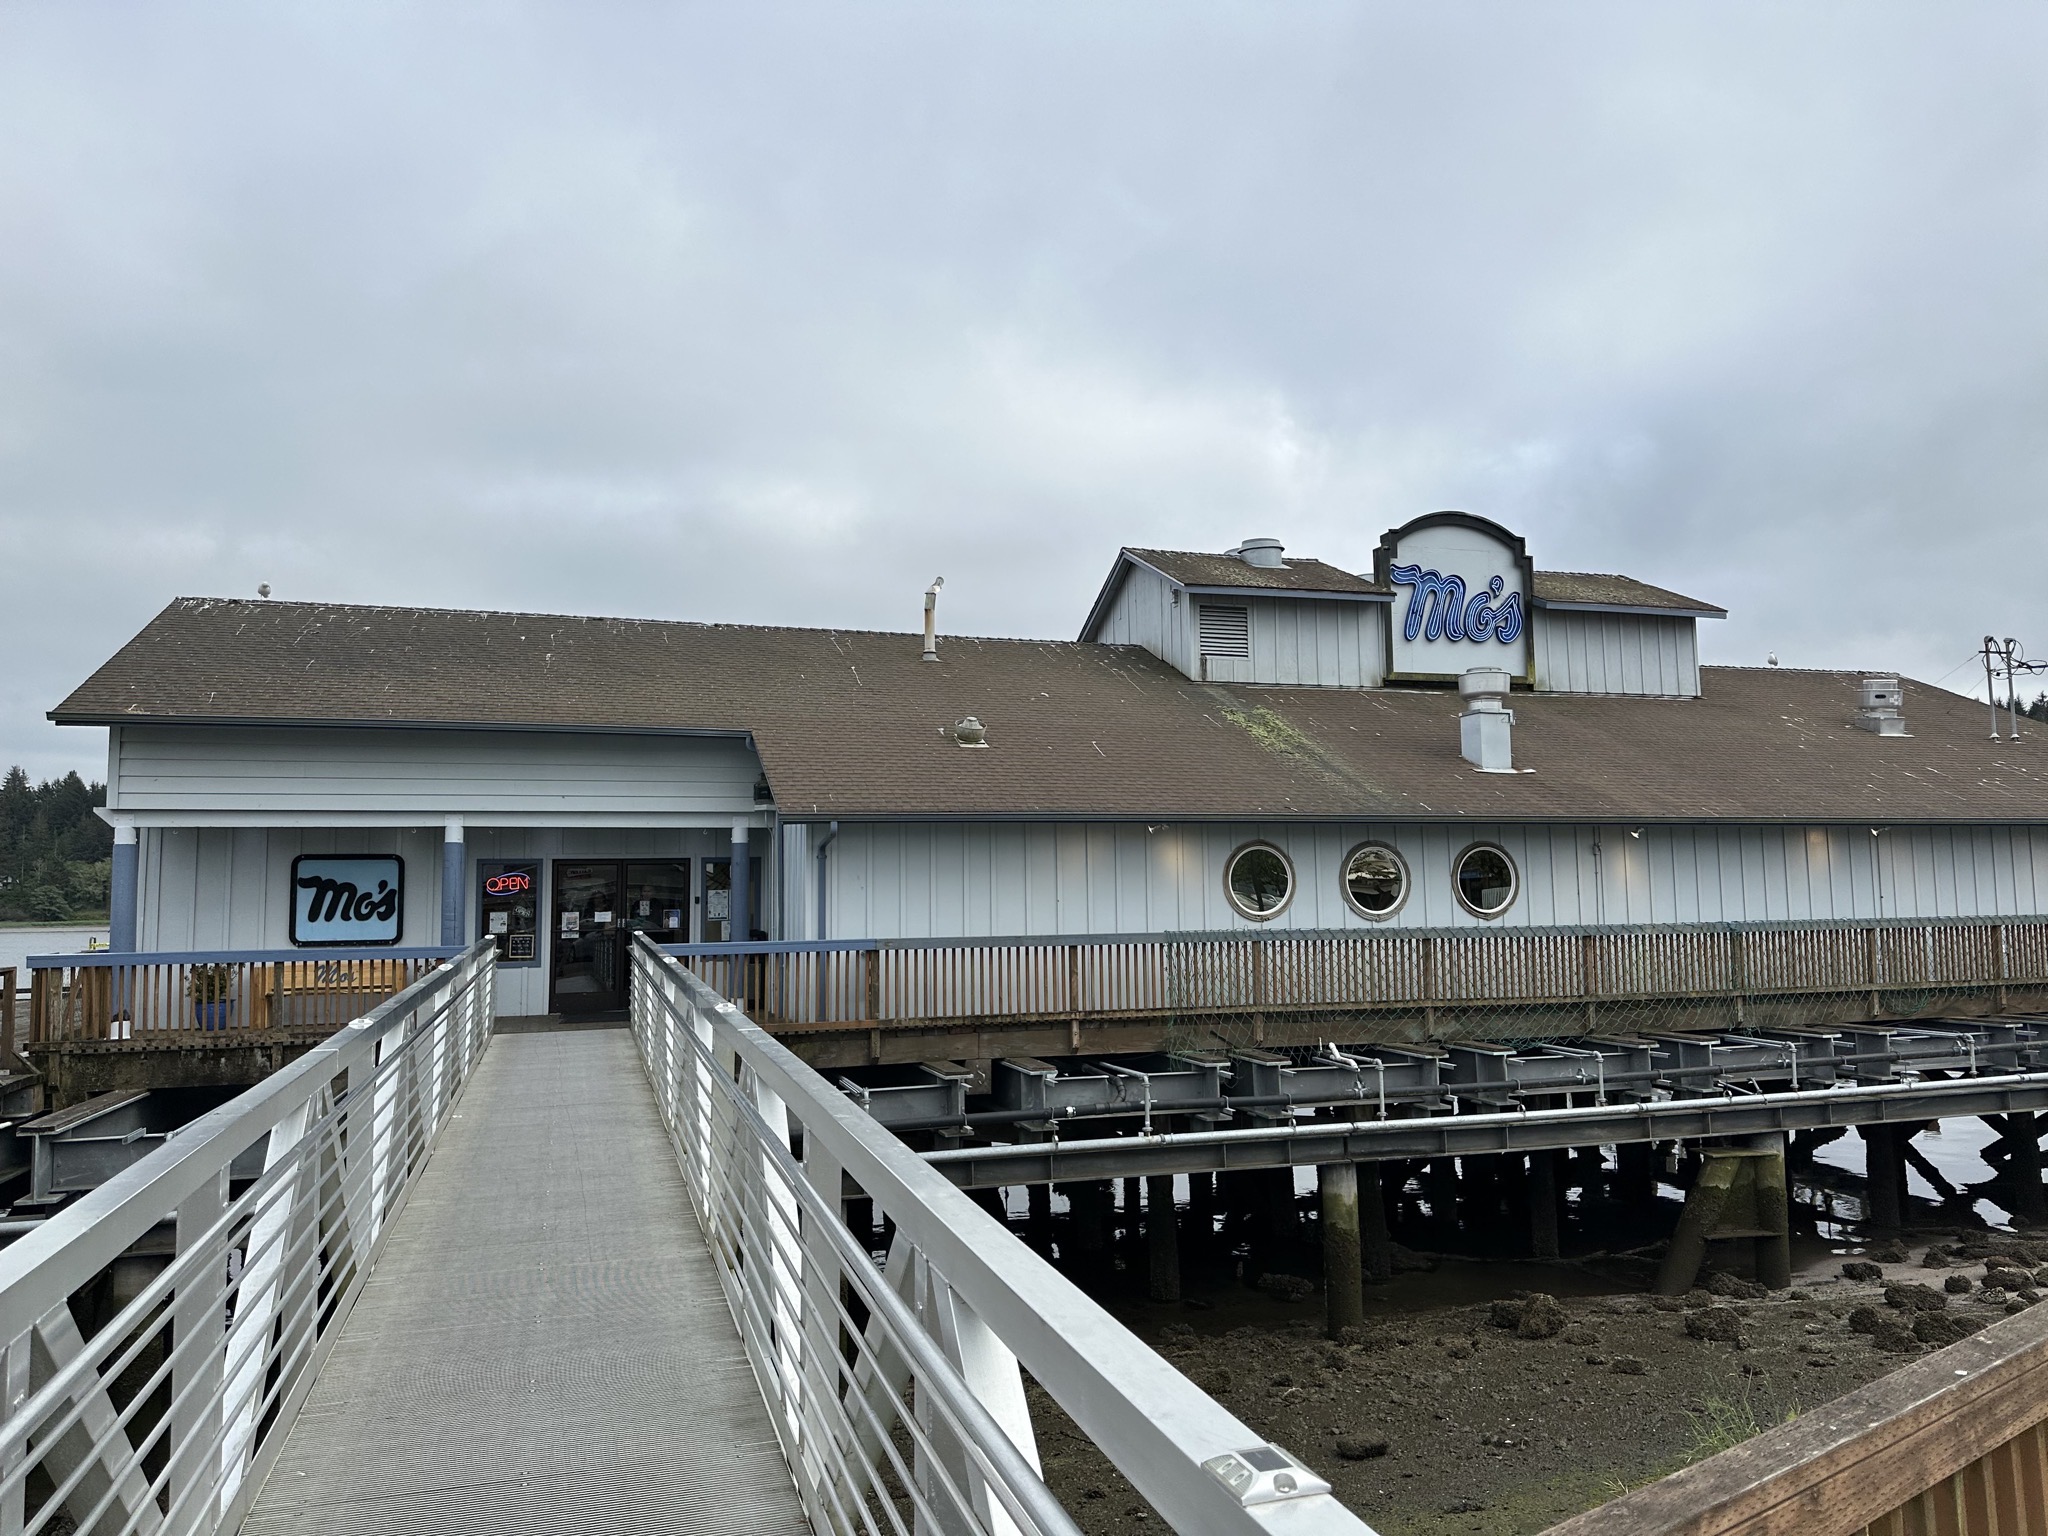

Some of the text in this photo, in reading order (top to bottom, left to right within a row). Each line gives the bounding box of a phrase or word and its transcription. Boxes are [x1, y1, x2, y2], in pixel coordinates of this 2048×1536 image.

[1390, 563, 1523, 644] Mo's
[298, 876, 397, 922] Mo's
[486, 877, 529, 891] OPEN
